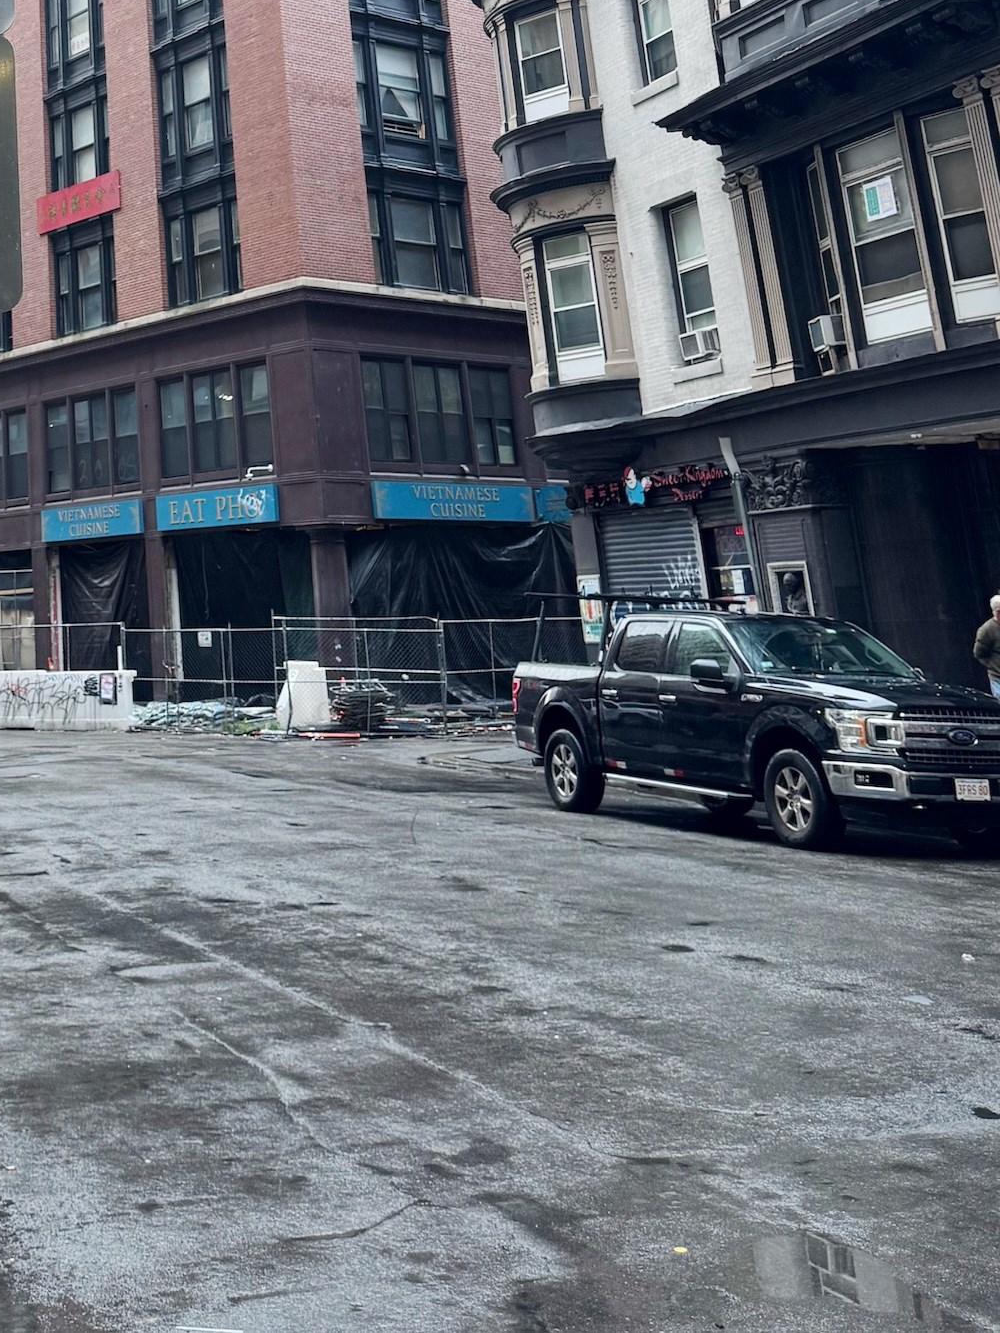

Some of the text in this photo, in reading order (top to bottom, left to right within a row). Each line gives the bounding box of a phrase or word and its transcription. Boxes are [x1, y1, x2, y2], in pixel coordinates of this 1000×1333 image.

[412, 484, 500, 502] VIETNAMESE
[58, 504, 120, 522] VIETNAMESE
[168, 498, 206, 525] EAT
[430, 502, 486, 518] CUISINE
[68, 520, 109, 538] CUISINE
